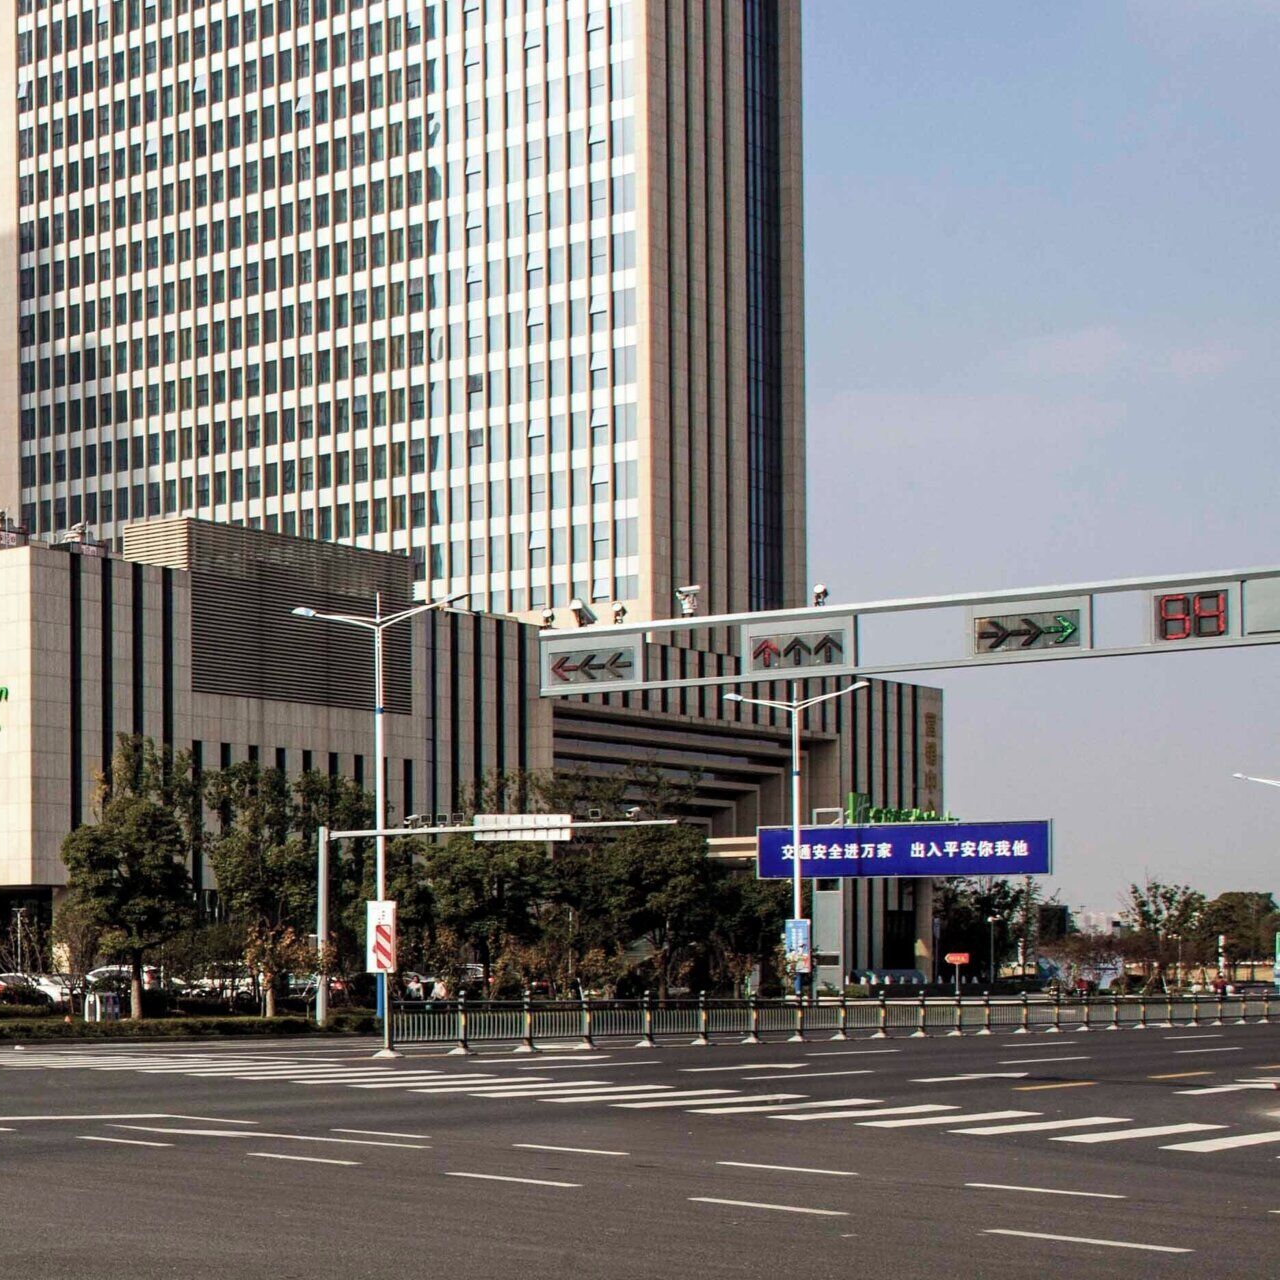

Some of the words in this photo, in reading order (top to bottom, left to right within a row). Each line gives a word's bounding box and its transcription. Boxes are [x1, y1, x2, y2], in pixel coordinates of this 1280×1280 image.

[781, 842, 892, 860] 交通安全进万家
[910, 840, 1028, 858] 出入平安你我他
